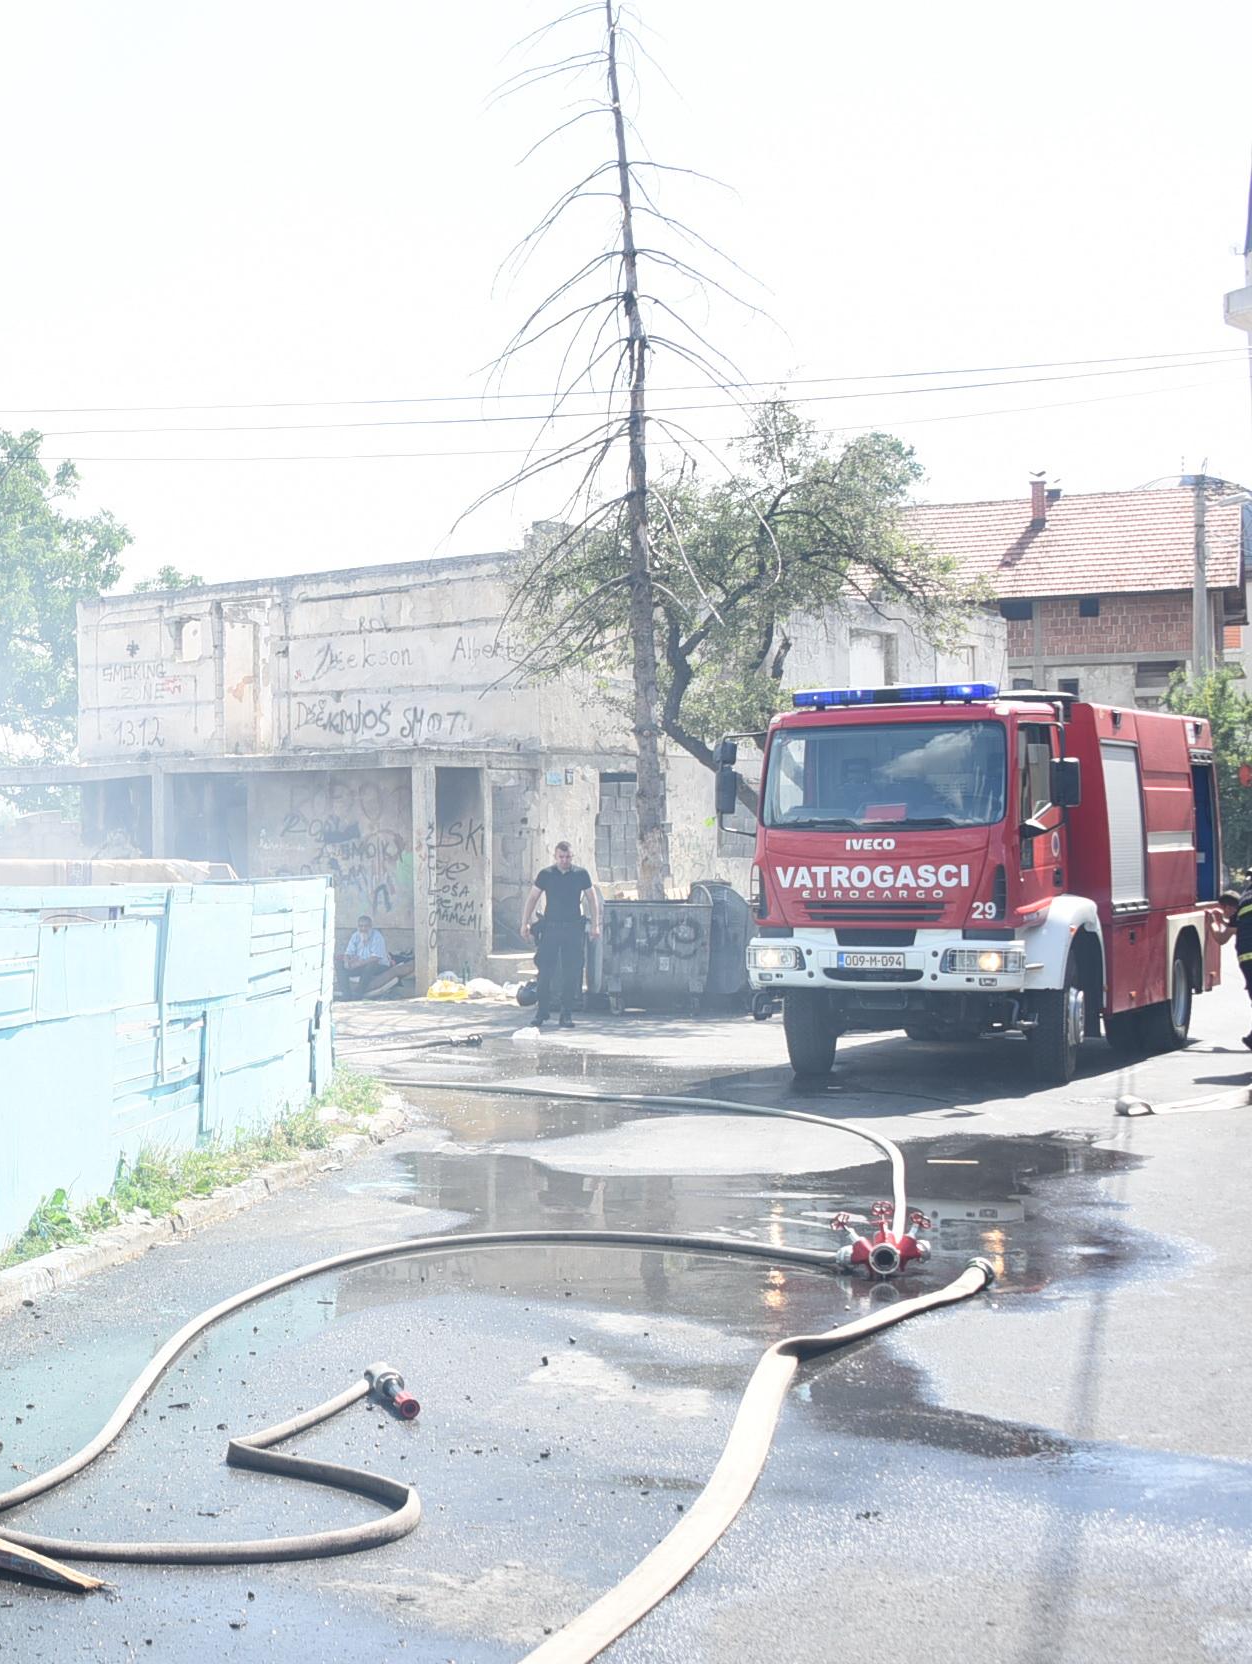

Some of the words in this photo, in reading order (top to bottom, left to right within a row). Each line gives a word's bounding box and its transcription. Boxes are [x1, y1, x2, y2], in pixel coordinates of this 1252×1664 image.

[101, 662, 167, 683] SMOKING
[120, 683, 165, 701] ZONE
[845, 837, 896, 851] IVECO
[775, 863, 970, 889] VATROGASCI
[802, 889, 945, 899] EUROCARGO
[971, 901, 997, 920] 29
